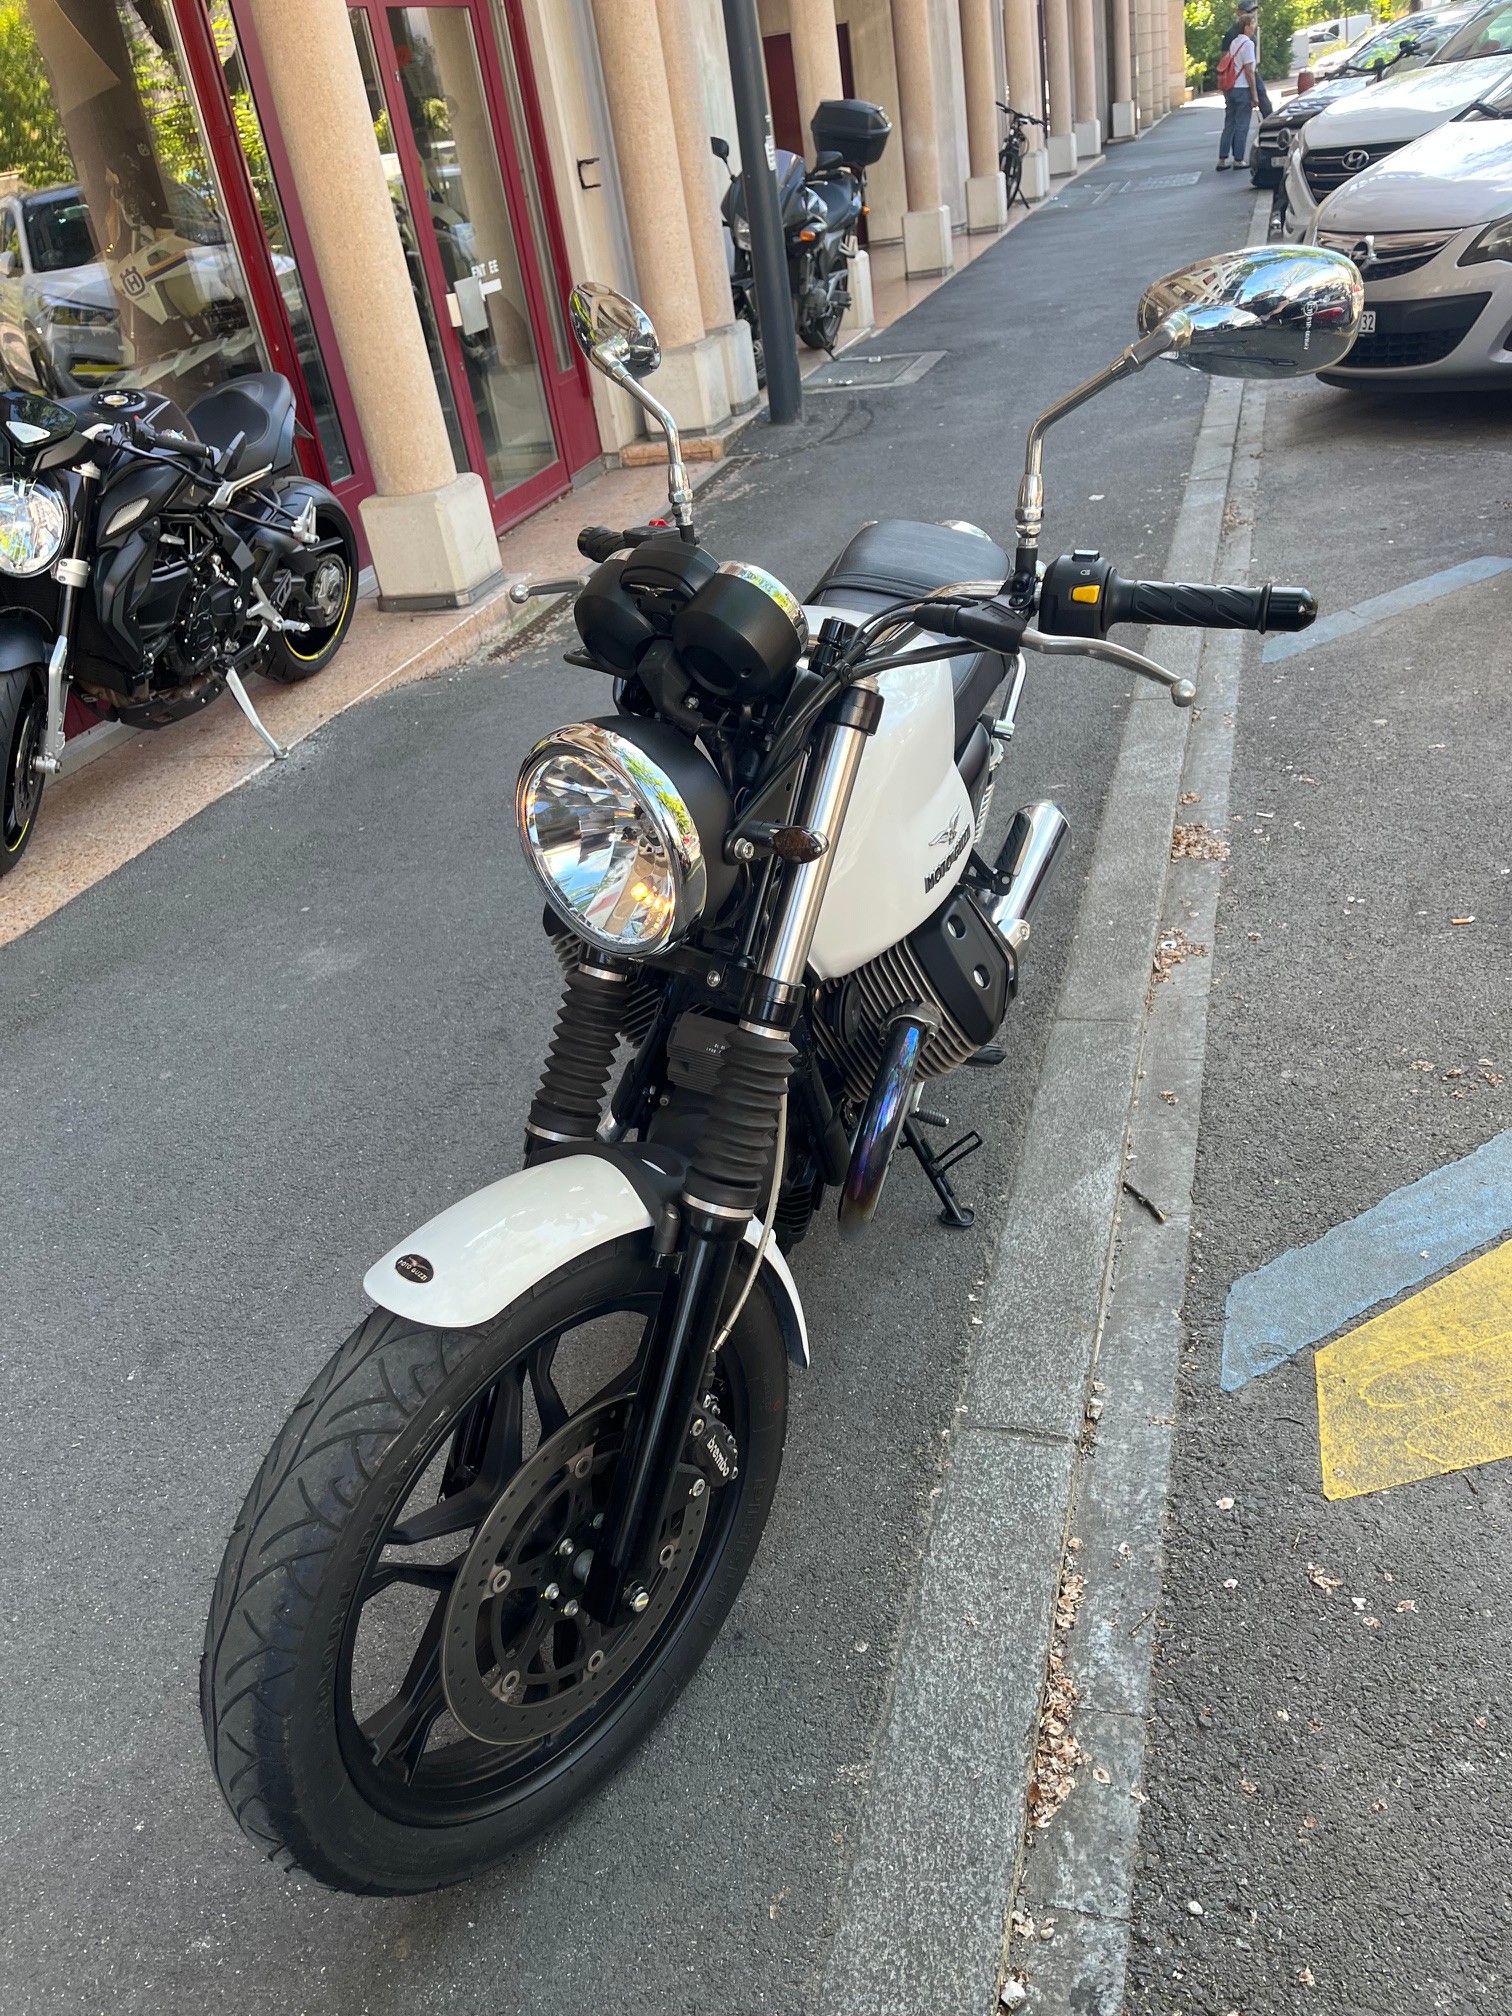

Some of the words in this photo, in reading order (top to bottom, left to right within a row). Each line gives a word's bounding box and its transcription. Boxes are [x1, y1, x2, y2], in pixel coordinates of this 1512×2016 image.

[923, 853, 953, 895] MOTO
[410, 1267, 428, 1281] GUZZI
[706, 1434, 730, 1477] brembo
